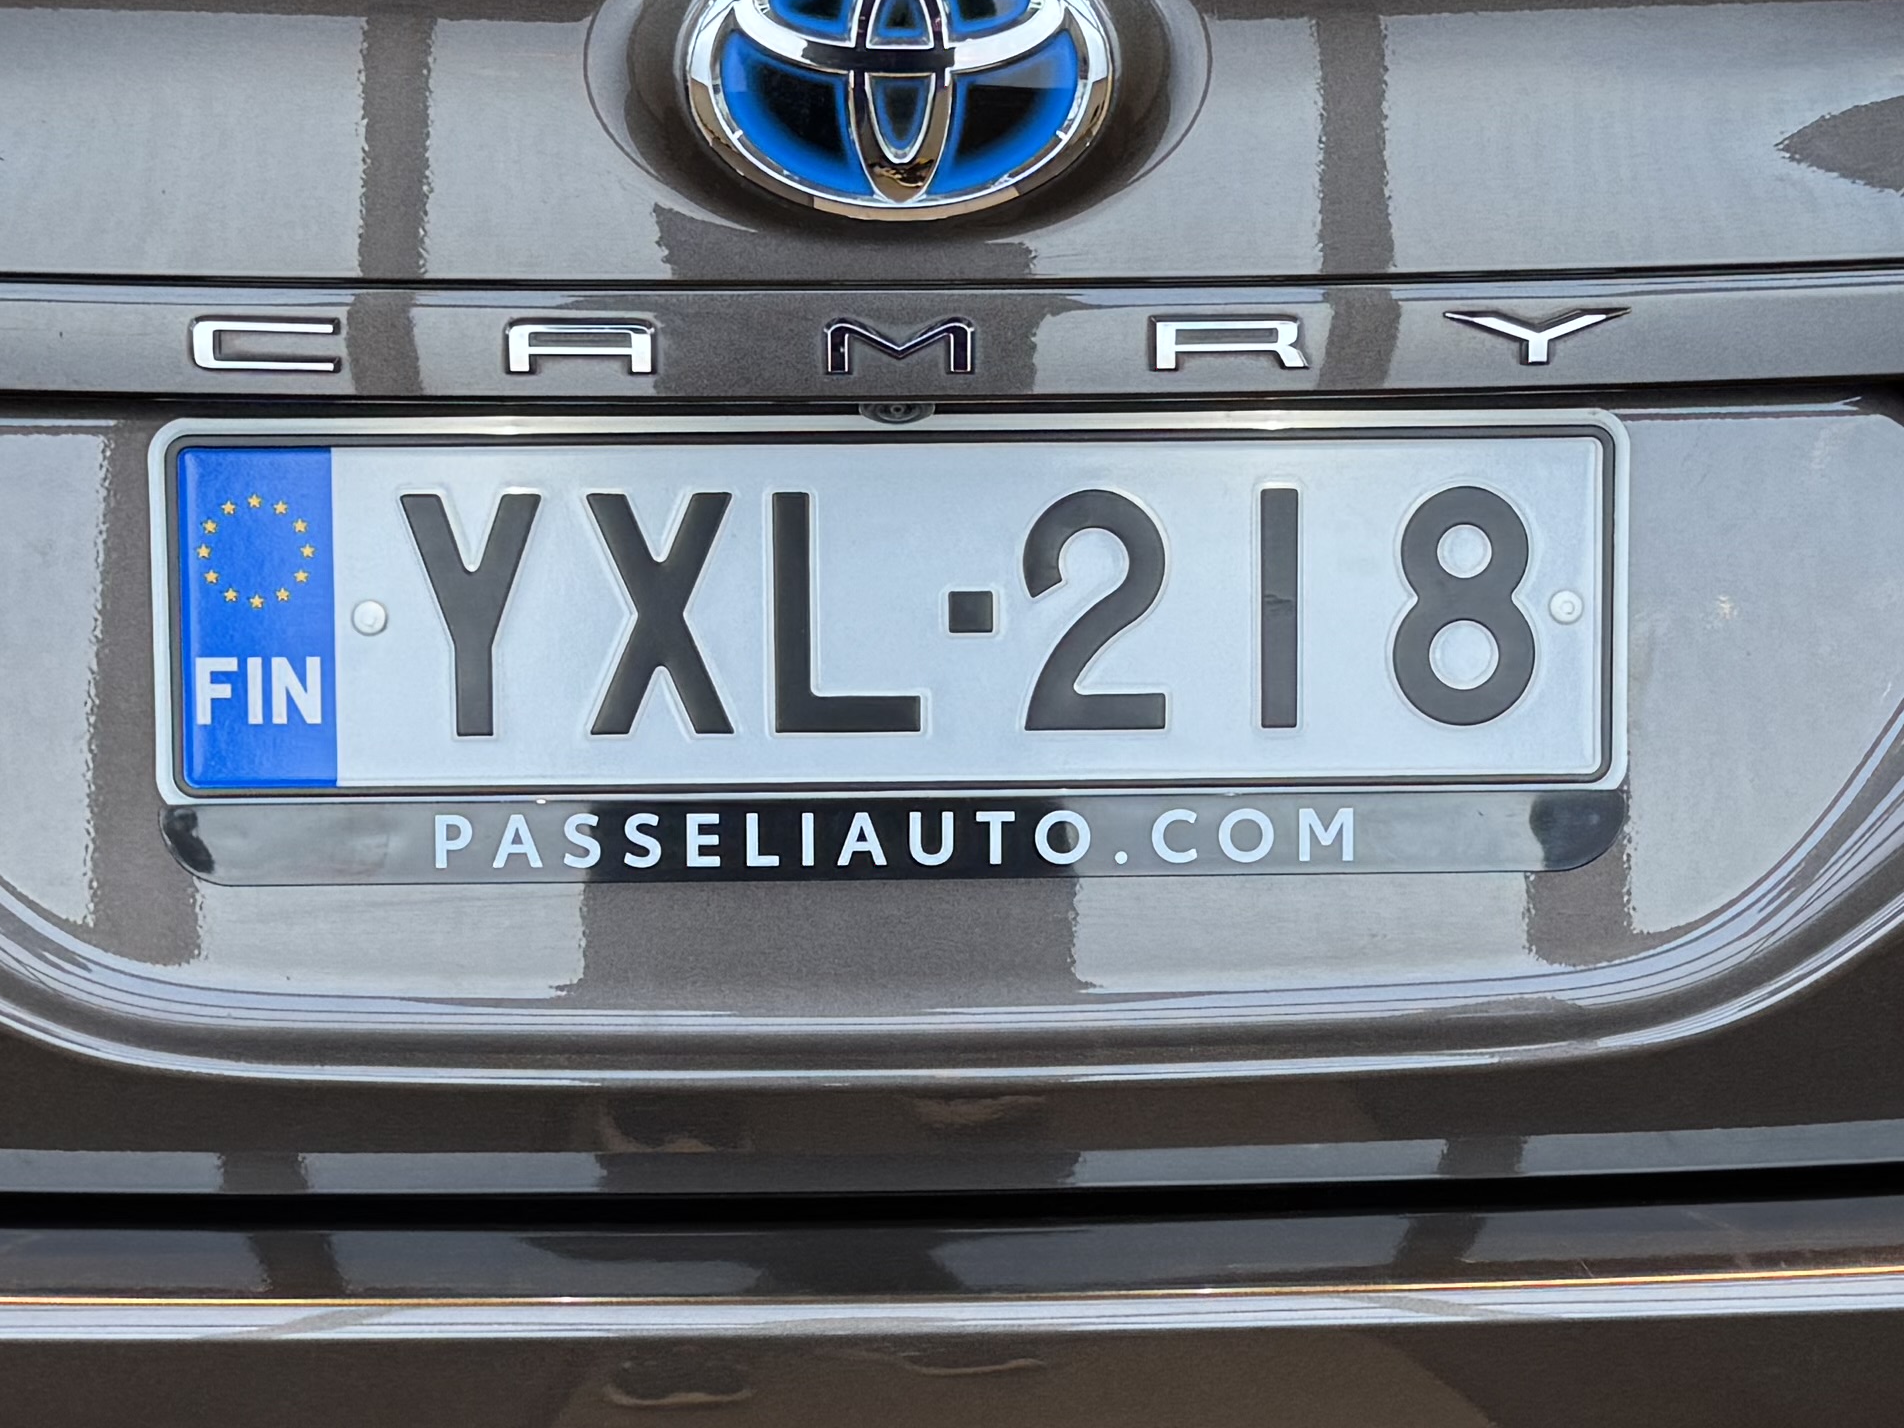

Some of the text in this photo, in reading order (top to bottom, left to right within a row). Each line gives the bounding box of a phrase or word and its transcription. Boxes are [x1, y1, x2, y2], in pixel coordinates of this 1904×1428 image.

[191, 307, 1632, 375] CAMRY
[400, 484, 1536, 737] YXL-218
[194, 655, 322, 726] FIN
[434, 808, 1356, 869] PASSELIAUTO.COM
